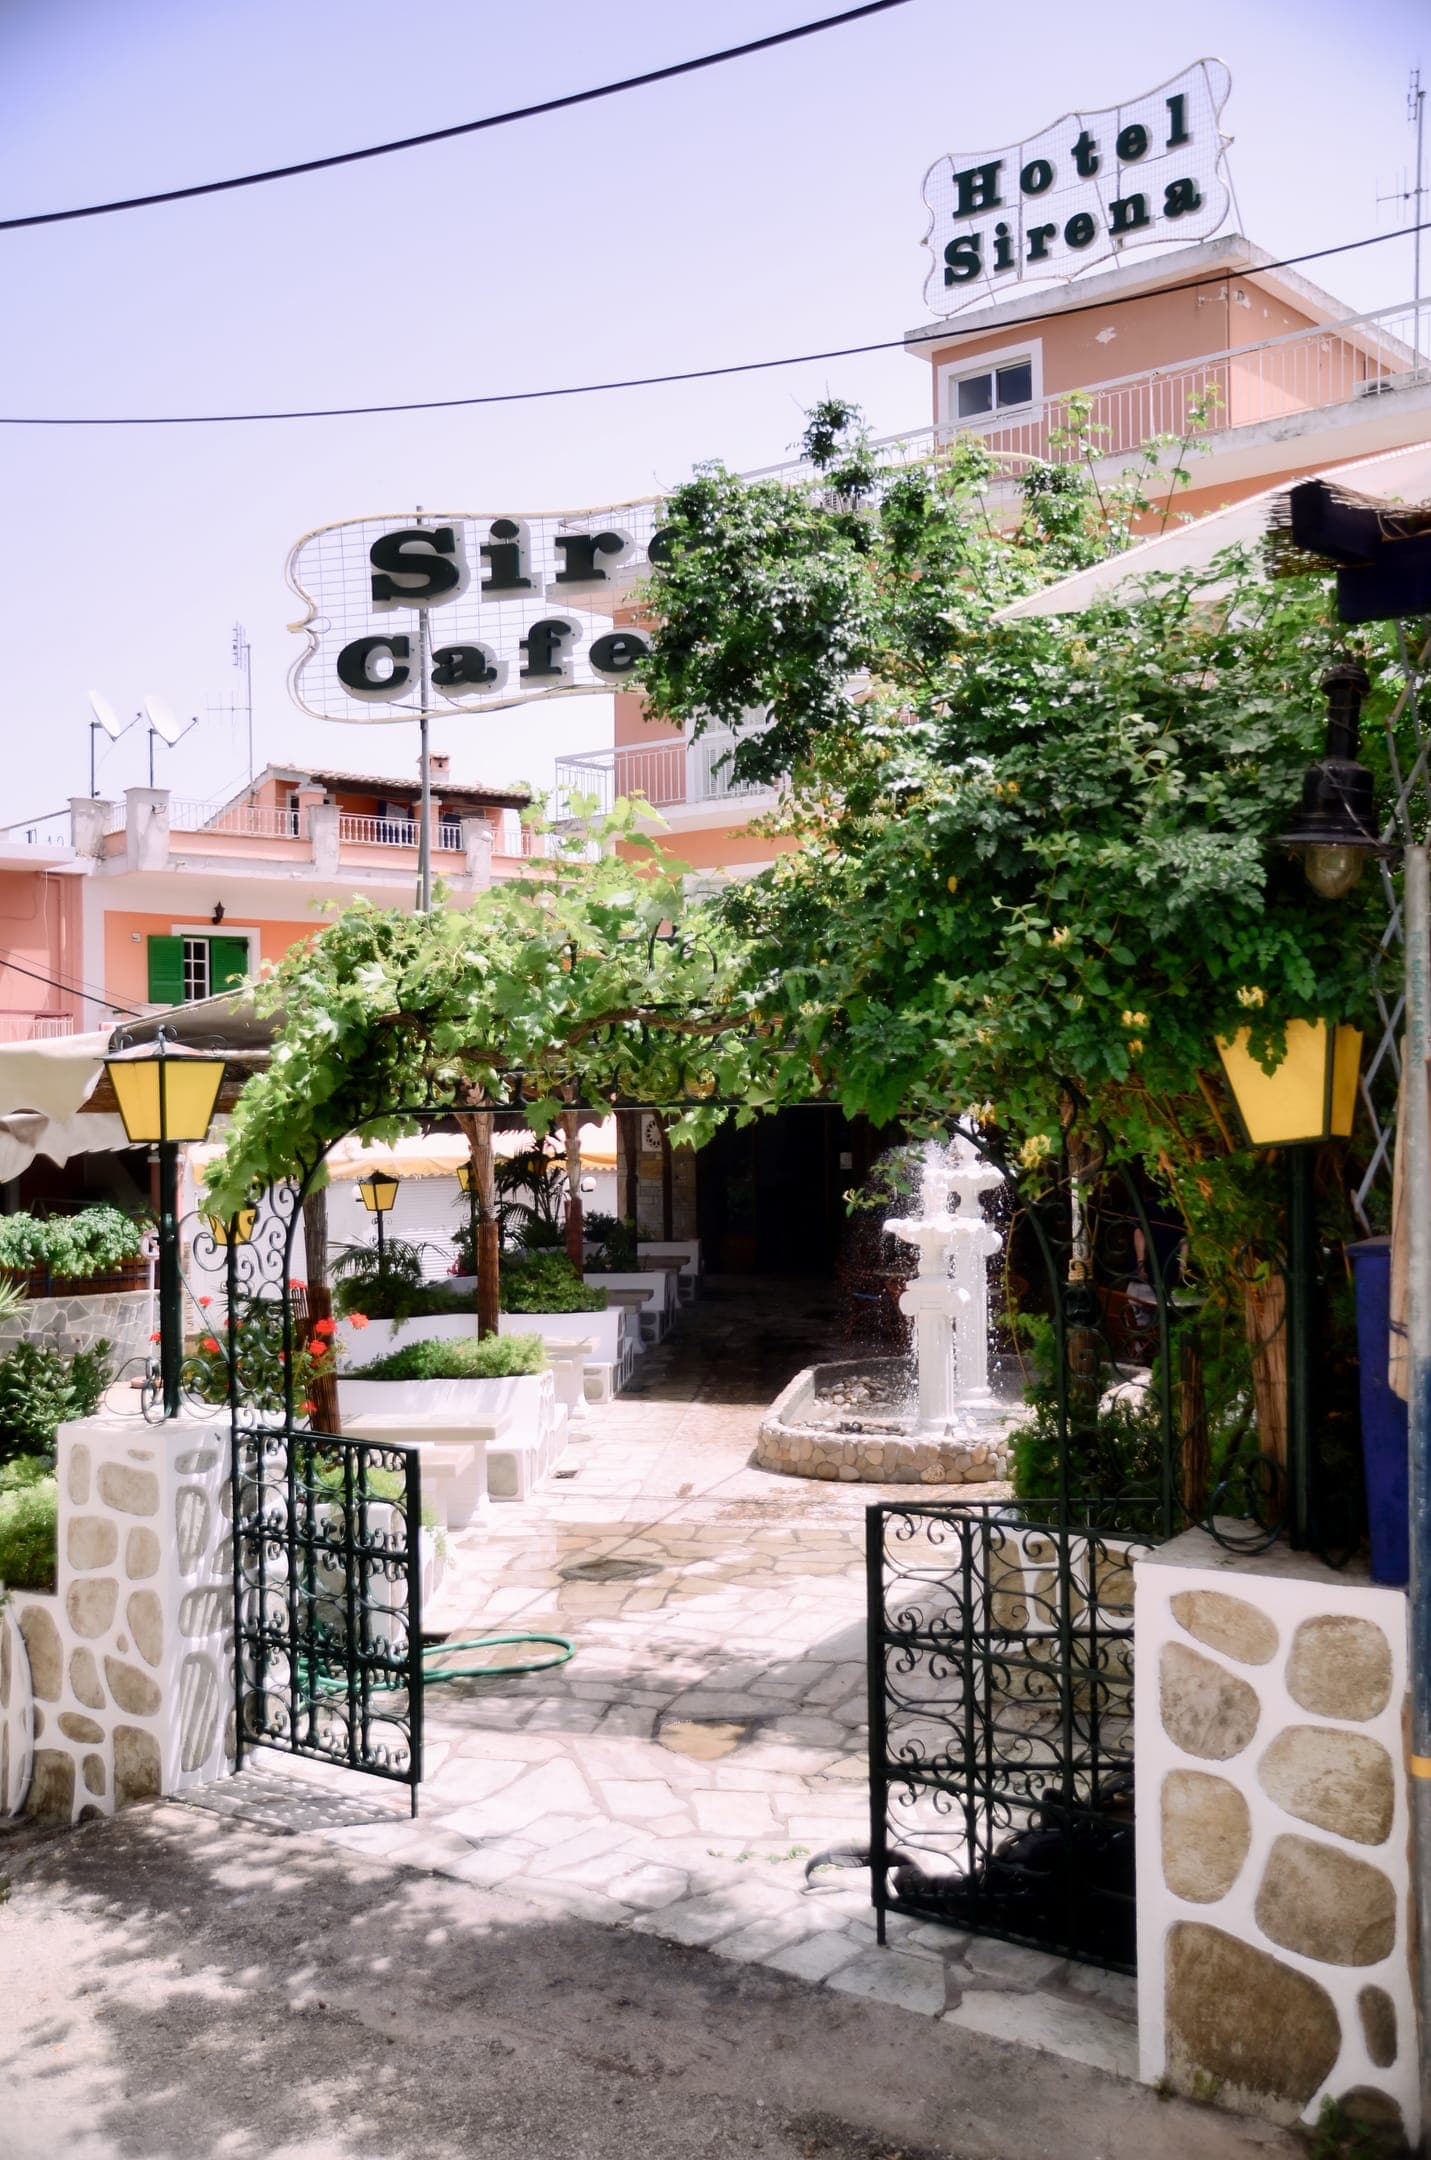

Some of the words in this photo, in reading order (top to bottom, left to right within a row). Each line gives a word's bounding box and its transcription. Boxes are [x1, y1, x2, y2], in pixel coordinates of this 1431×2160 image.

[953, 93, 1190, 219] Hotel
[944, 177, 1202, 286] Sirena
[337, 620, 652, 690] Cafe
